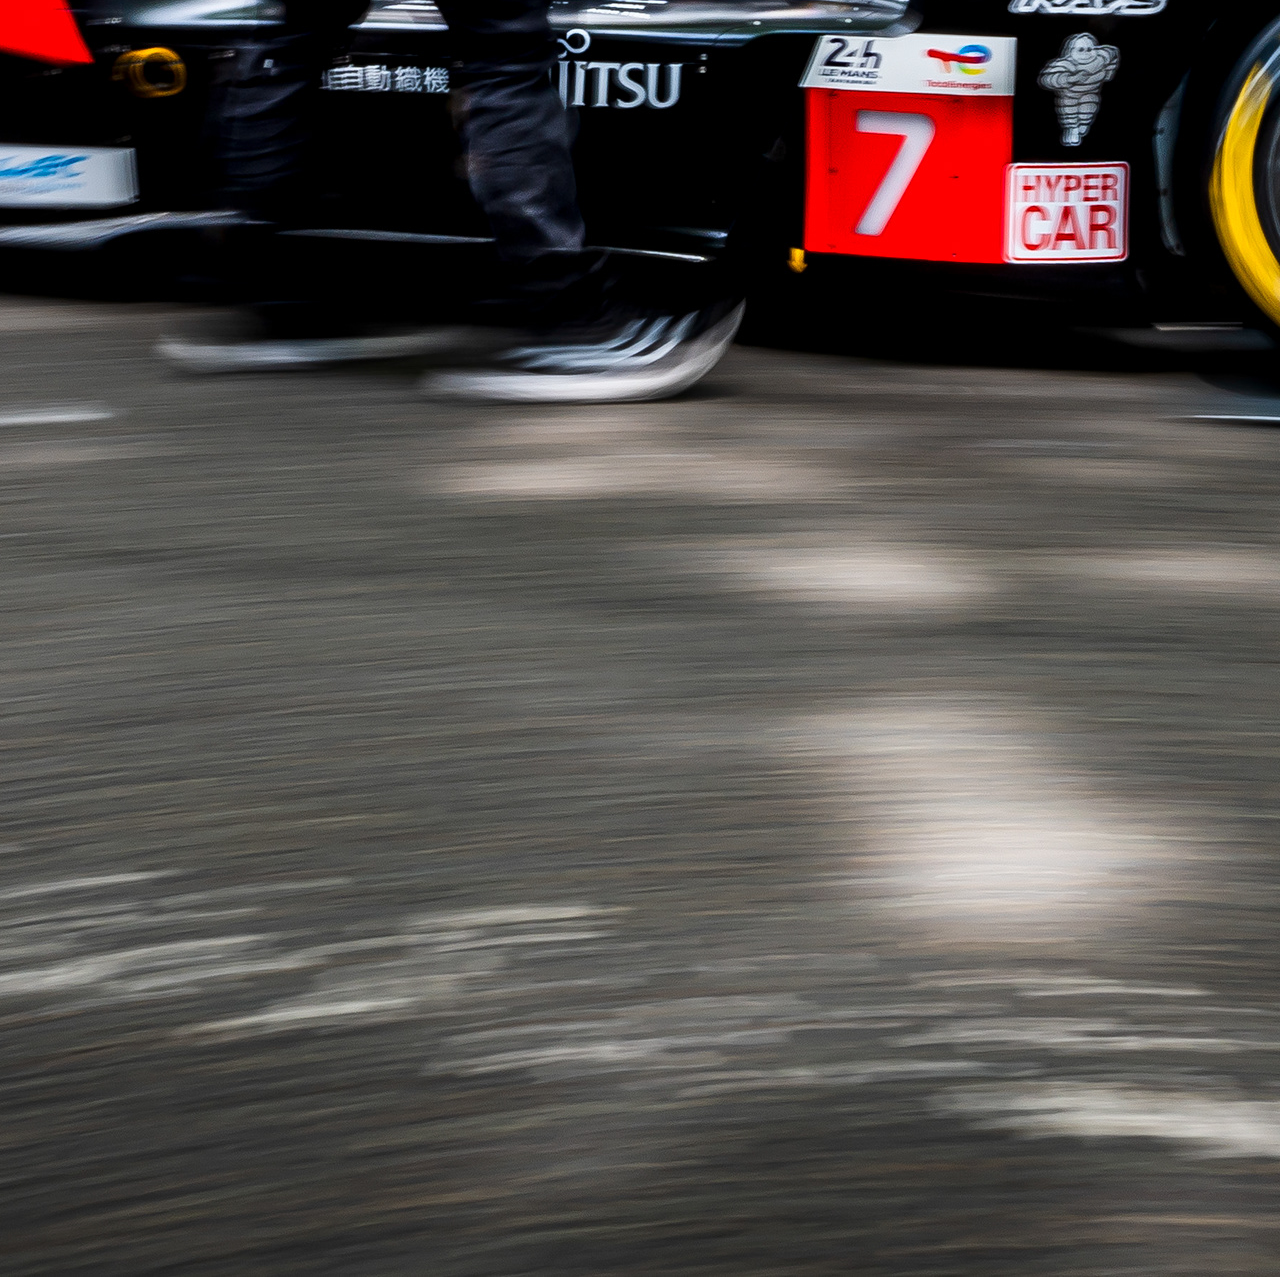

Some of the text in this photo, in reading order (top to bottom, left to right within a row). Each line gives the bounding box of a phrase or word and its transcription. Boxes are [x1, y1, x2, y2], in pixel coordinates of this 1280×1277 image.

[322, 64, 450, 93] 自動織機
[840, 70, 880, 79] MANS
[925, 79, 993, 91] TotalEnergies
[855, 109, 937, 237] 7
[1020, 173, 1119, 203] HYPER
[1020, 204, 1119, 251] CAR
